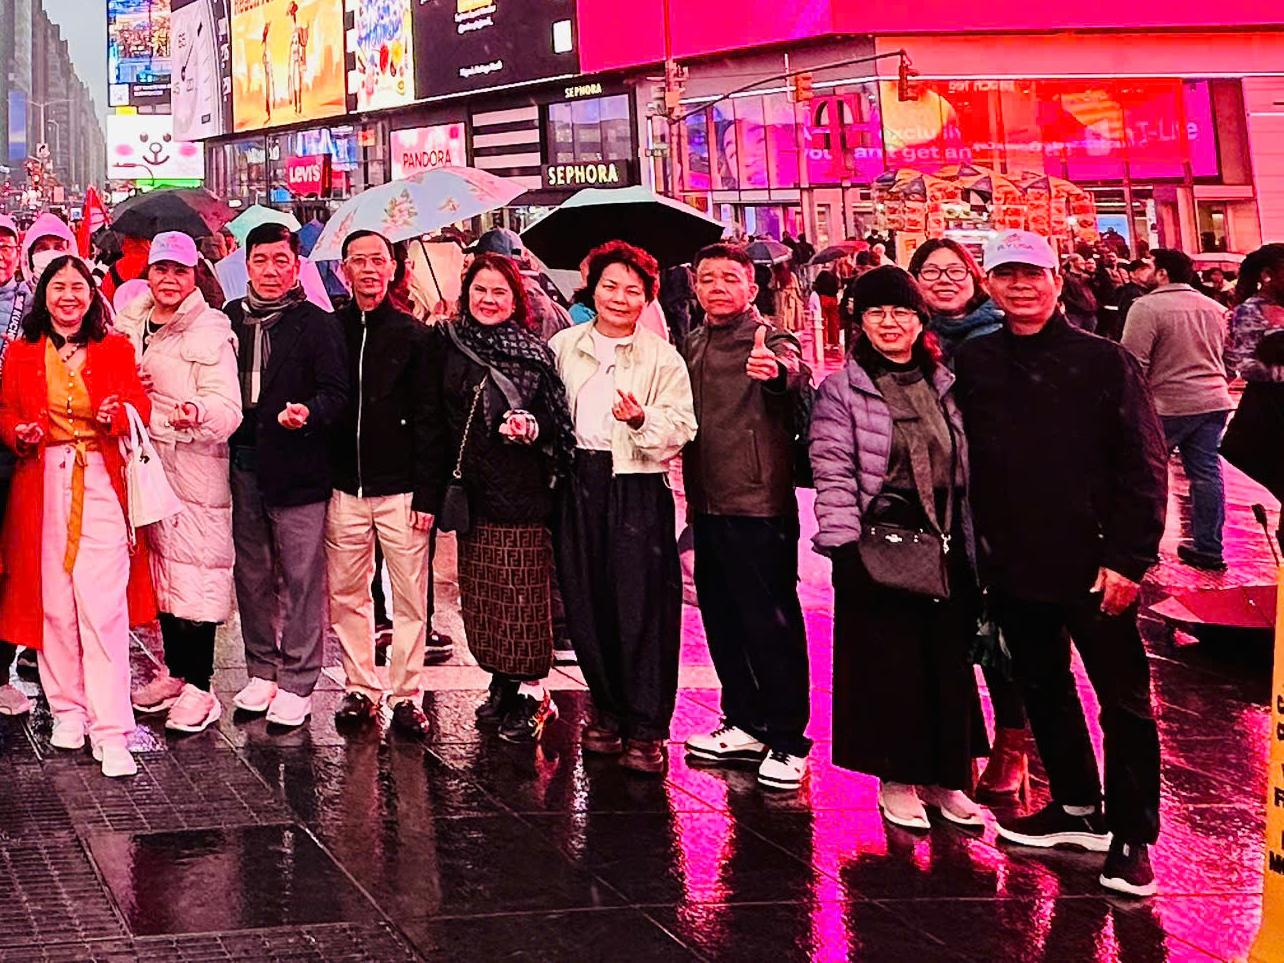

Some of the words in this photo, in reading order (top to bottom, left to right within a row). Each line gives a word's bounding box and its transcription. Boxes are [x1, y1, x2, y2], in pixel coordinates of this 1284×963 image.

[565, 83, 602, 98] SEPHORA
[403, 149, 452, 168] PANDORA
[548, 163, 619, 186] SEPHORA
